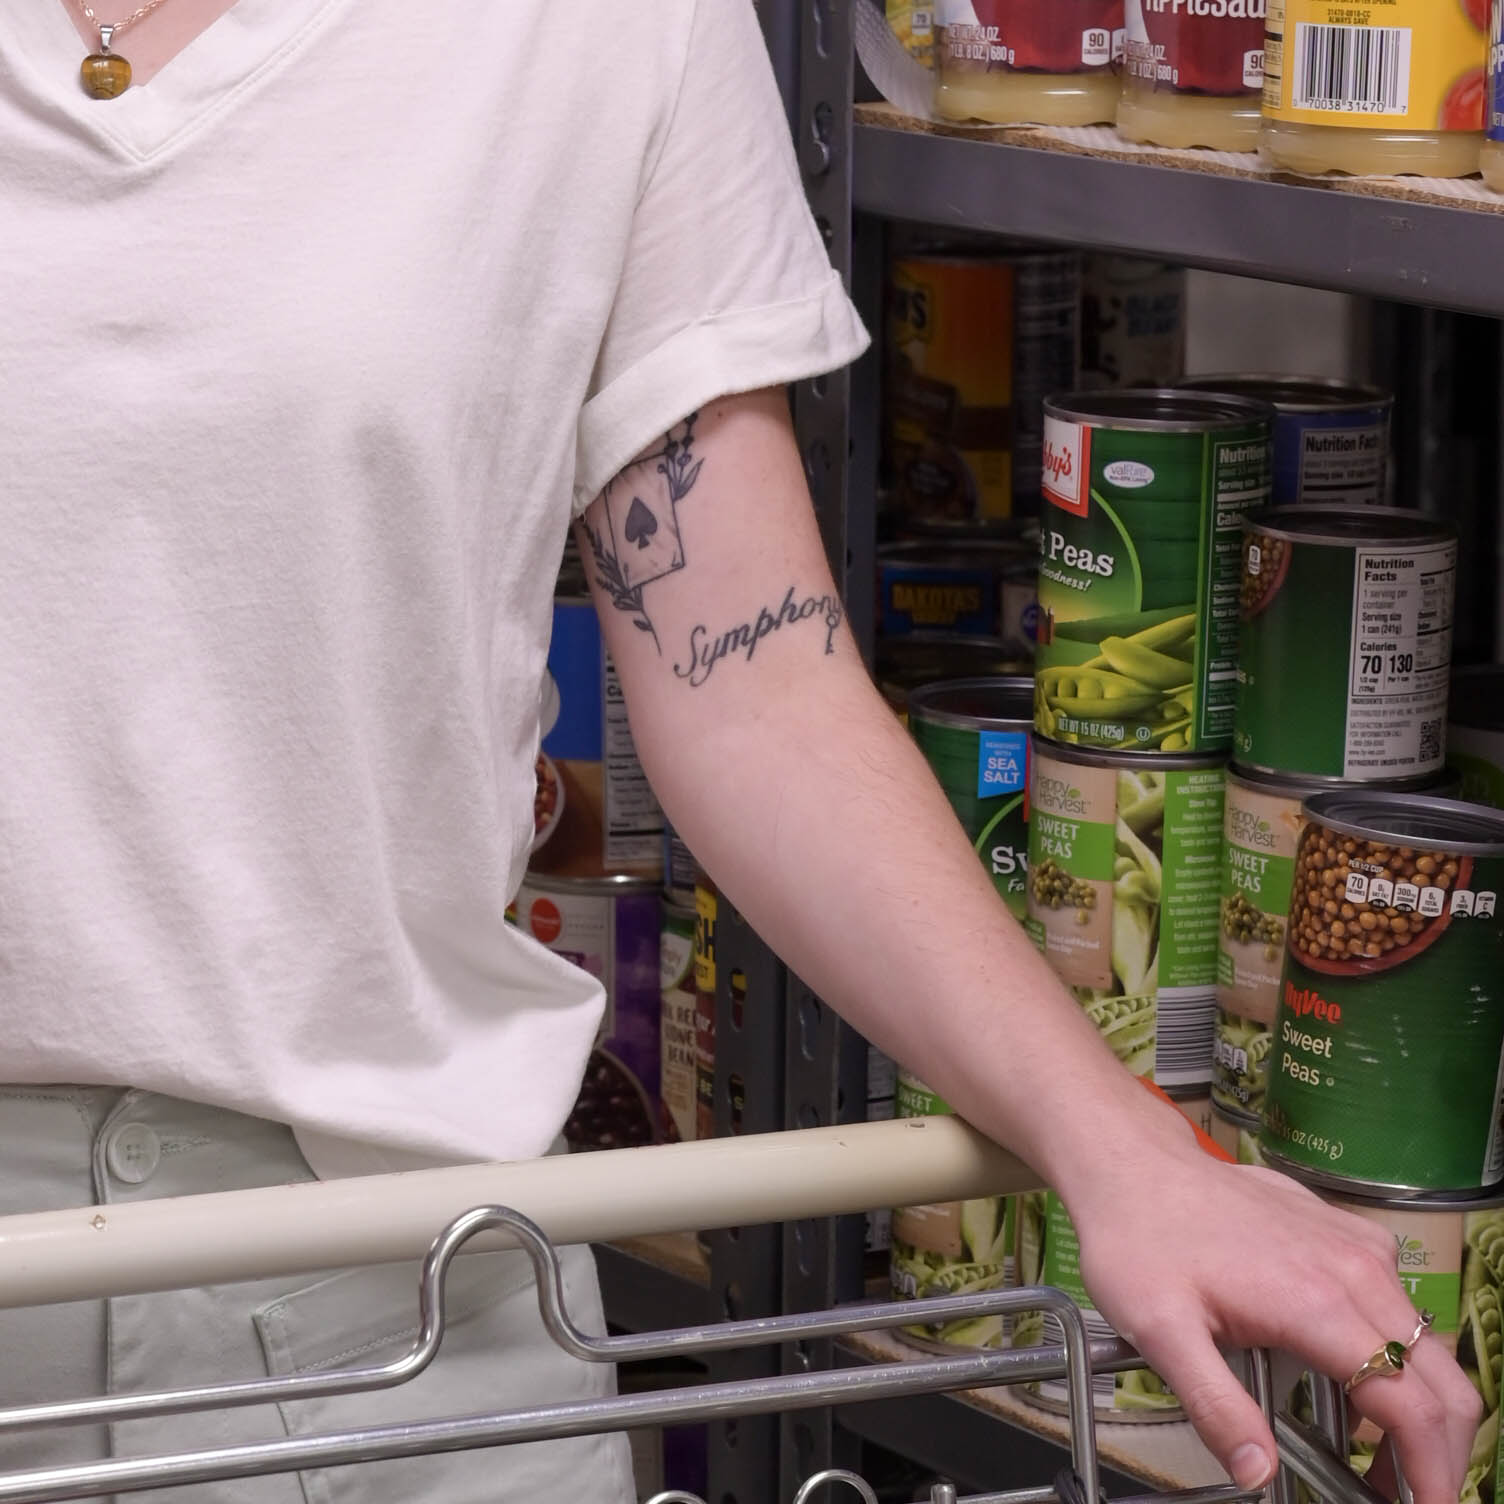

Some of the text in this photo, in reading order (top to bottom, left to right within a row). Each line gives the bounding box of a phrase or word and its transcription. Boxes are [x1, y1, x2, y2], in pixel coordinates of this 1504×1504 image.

[1089, 33, 1105, 47] 90
[990, 45, 1007, 61] 680
[1008, 48, 1015, 65] g
[1157, 66, 1171, 81] 680
[1309, 99, 1341, 111] 70038
[1347, 101, 1385, 113] 31470
[1305, 436, 1356, 452] Nutrition
[1049, 531, 1114, 577] Peas
[1365, 559, 1414, 569] Nutrition
[1364, 571, 1397, 582] Facts
[1362, 612, 1388, 623] Serving
[674, 586, 845, 687] Symphony
[1360, 642, 1397, 651] Calories
[1361, 653, 1413, 674] 70 130
[1081, 720, 1088, 734] 15
[1090, 721, 1099, 735] OZ
[1100, 723, 1124, 740] (425g)
[987, 757, 1017, 771] SEA
[983, 770, 1020, 785] SALT
[1037, 815, 1080, 841] SWEET
[1041, 837, 1073, 859] PEAS
[1228, 847, 1269, 874] SWEET
[1370, 863, 1384, 874] CUP
[1231, 871, 1262, 893] PEAS
[1351, 876, 1363, 889] 70
[1282, 1020, 1333, 1058] Sweet
[1282, 1052, 1320, 1086] Peas
[1292, 1128, 1344, 1160] OZ (425 g)
